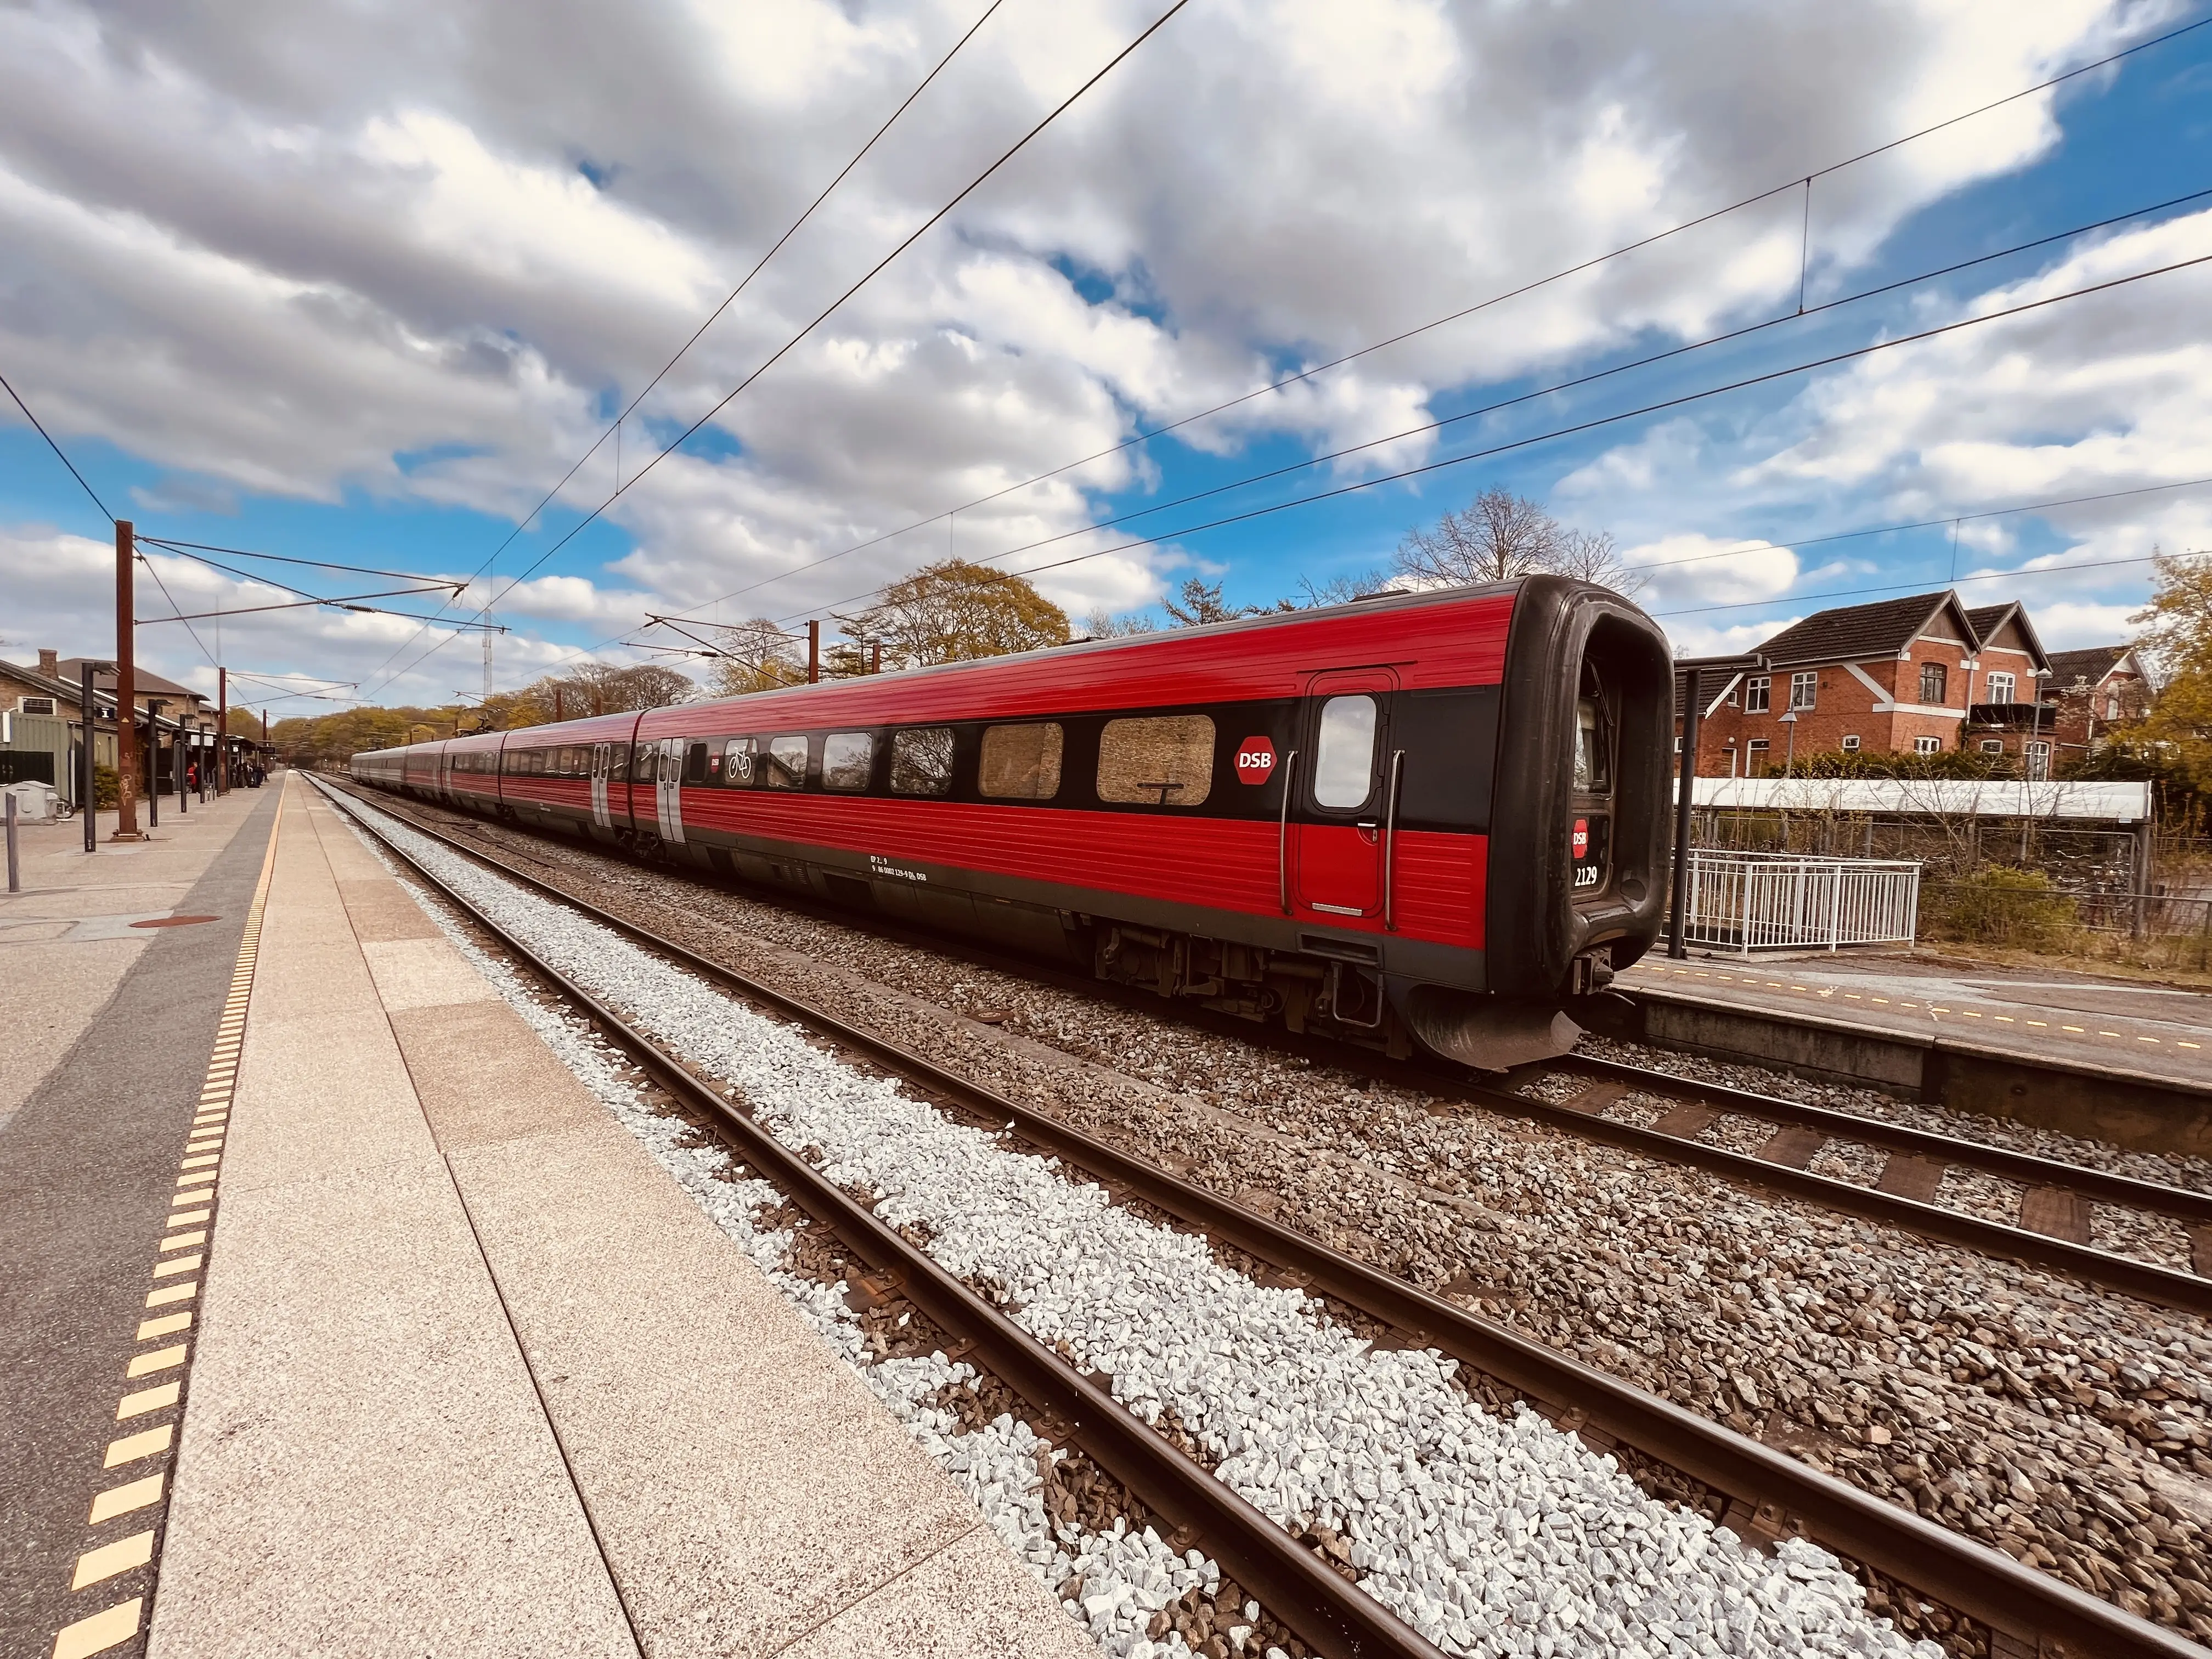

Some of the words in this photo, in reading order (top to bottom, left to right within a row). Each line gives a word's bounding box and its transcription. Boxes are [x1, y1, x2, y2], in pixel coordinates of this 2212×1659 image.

[1239, 752, 1271, 768] DSB
[1573, 832, 1587, 845] DSB
[1575, 866, 1598, 887] 2129
